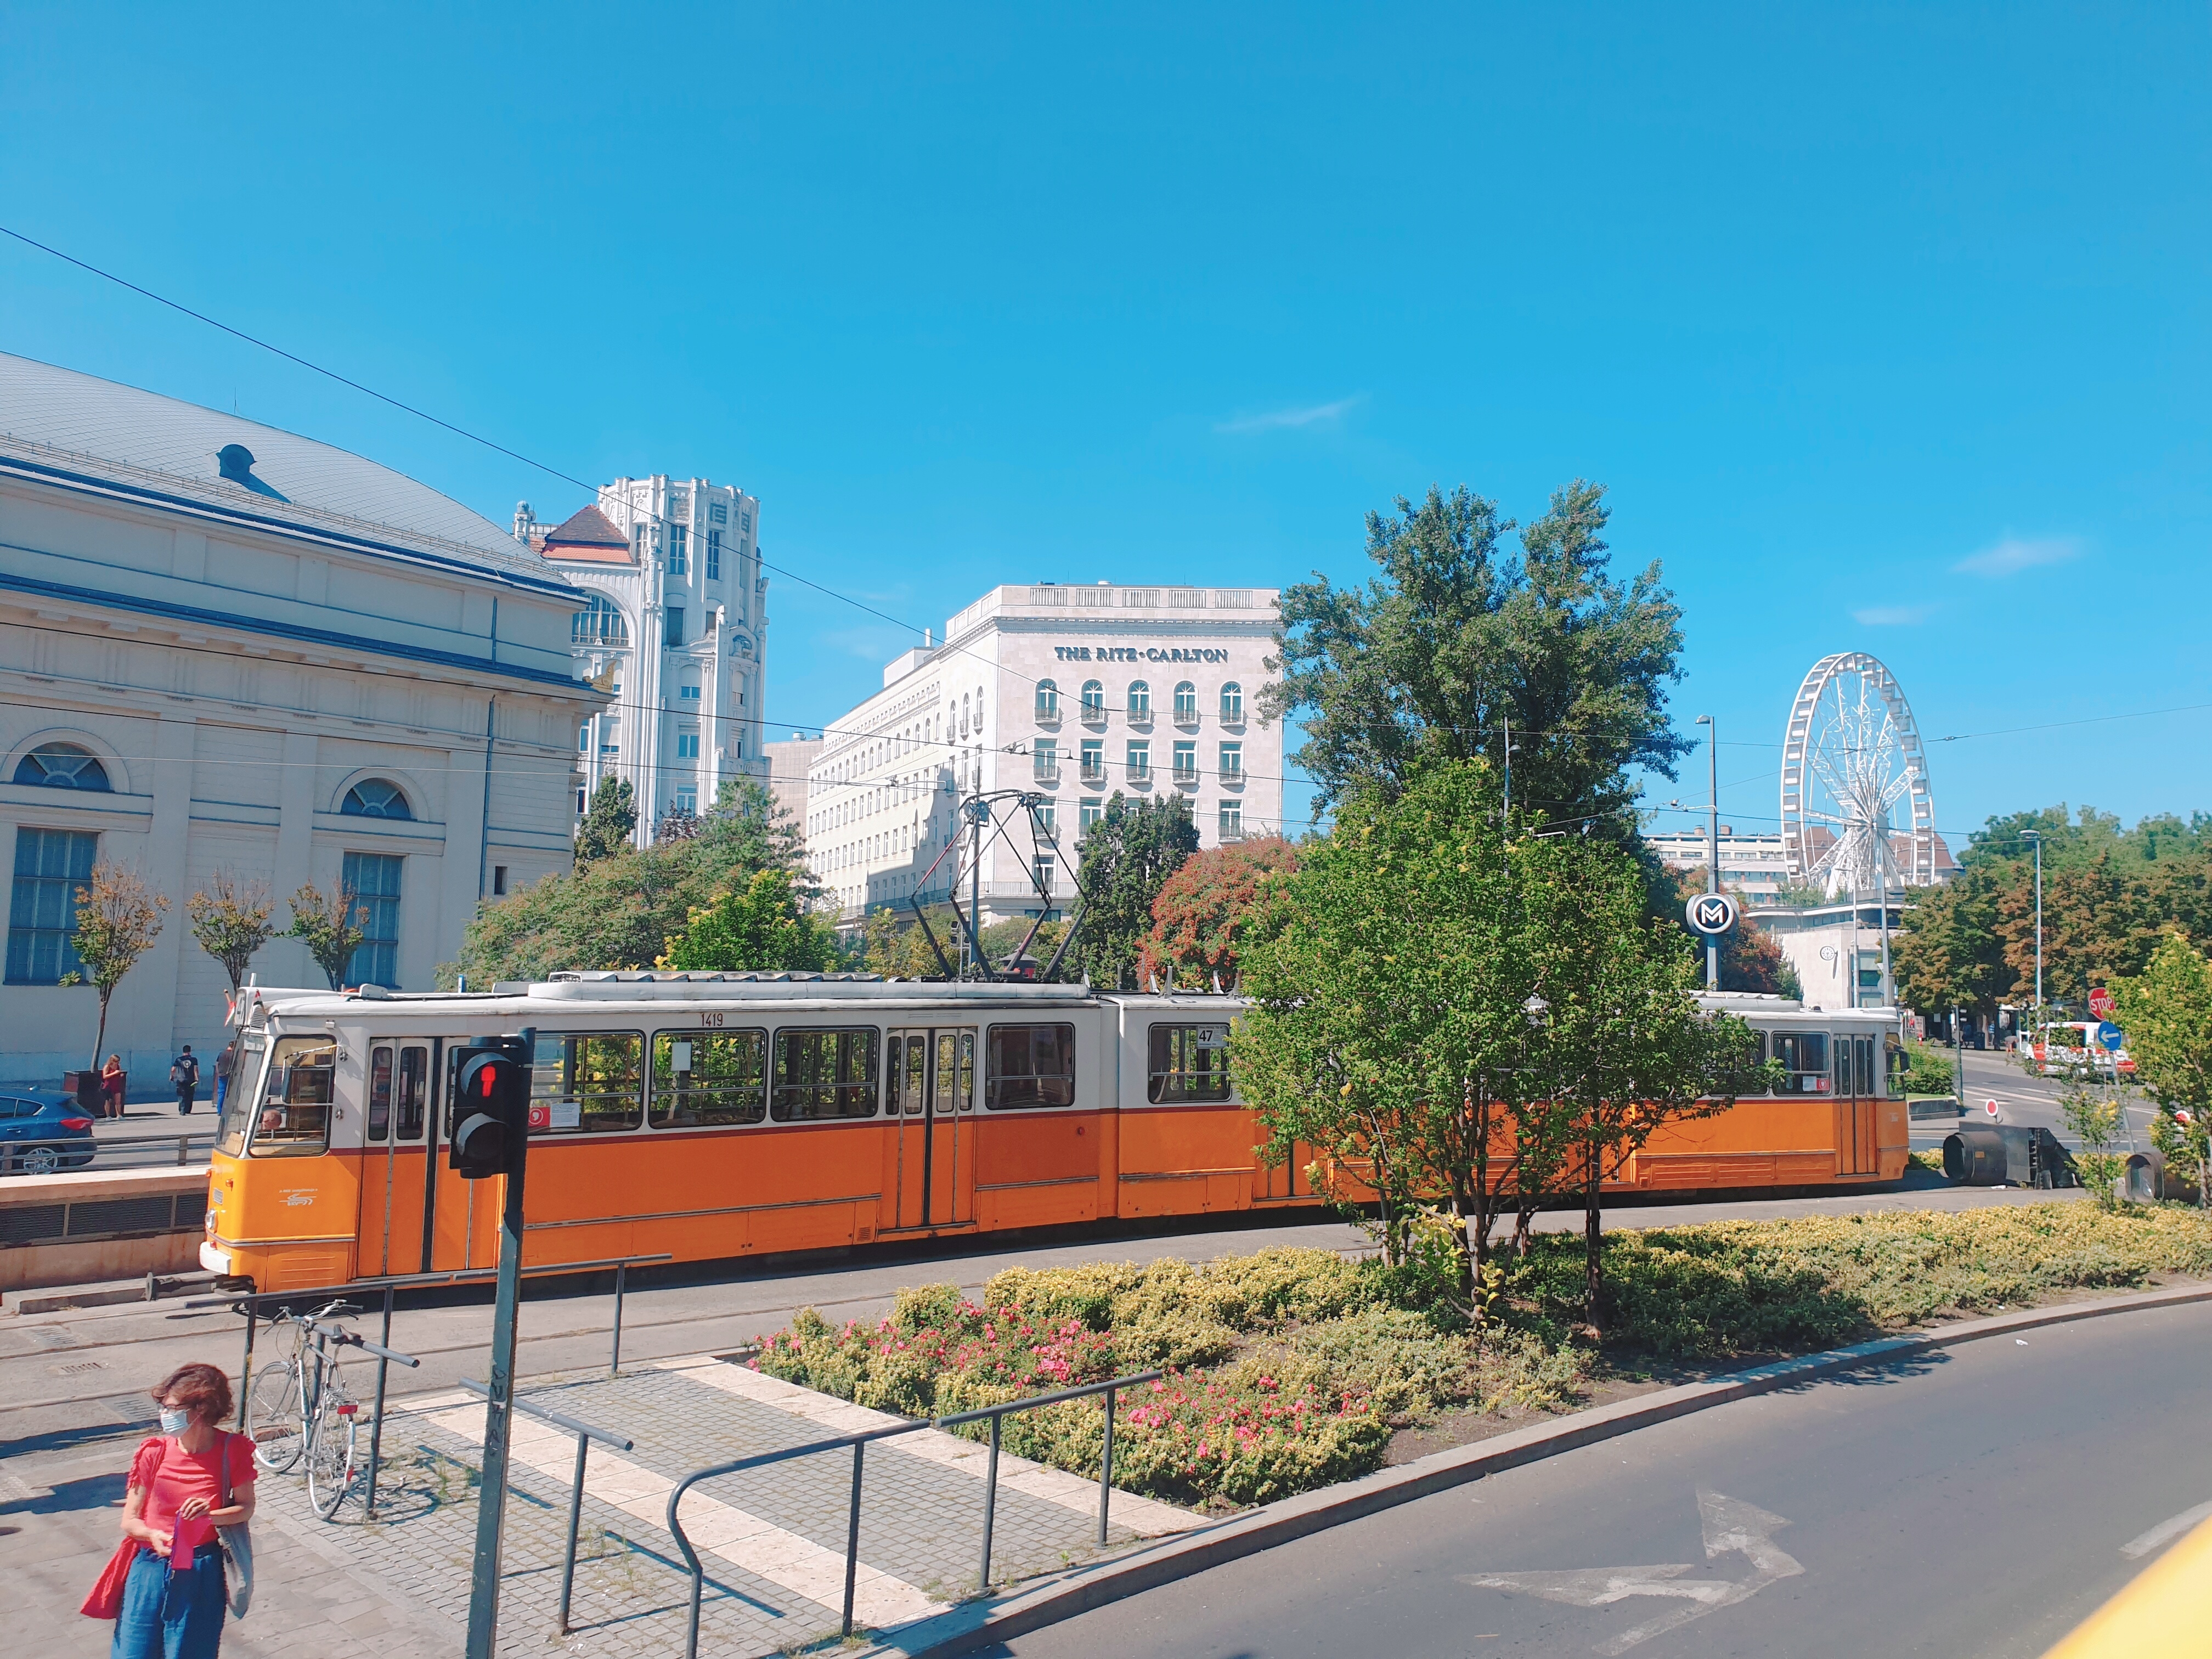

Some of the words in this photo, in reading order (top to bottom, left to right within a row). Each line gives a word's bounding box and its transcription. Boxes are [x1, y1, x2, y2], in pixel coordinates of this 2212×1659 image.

[1054, 647, 1092, 662] THE
[1701, 903, 1723, 923] M
[2091, 996, 2112, 1011] STOP
[702, 1013, 723, 1026] 1419
[1199, 1030, 1213, 1042] 47
